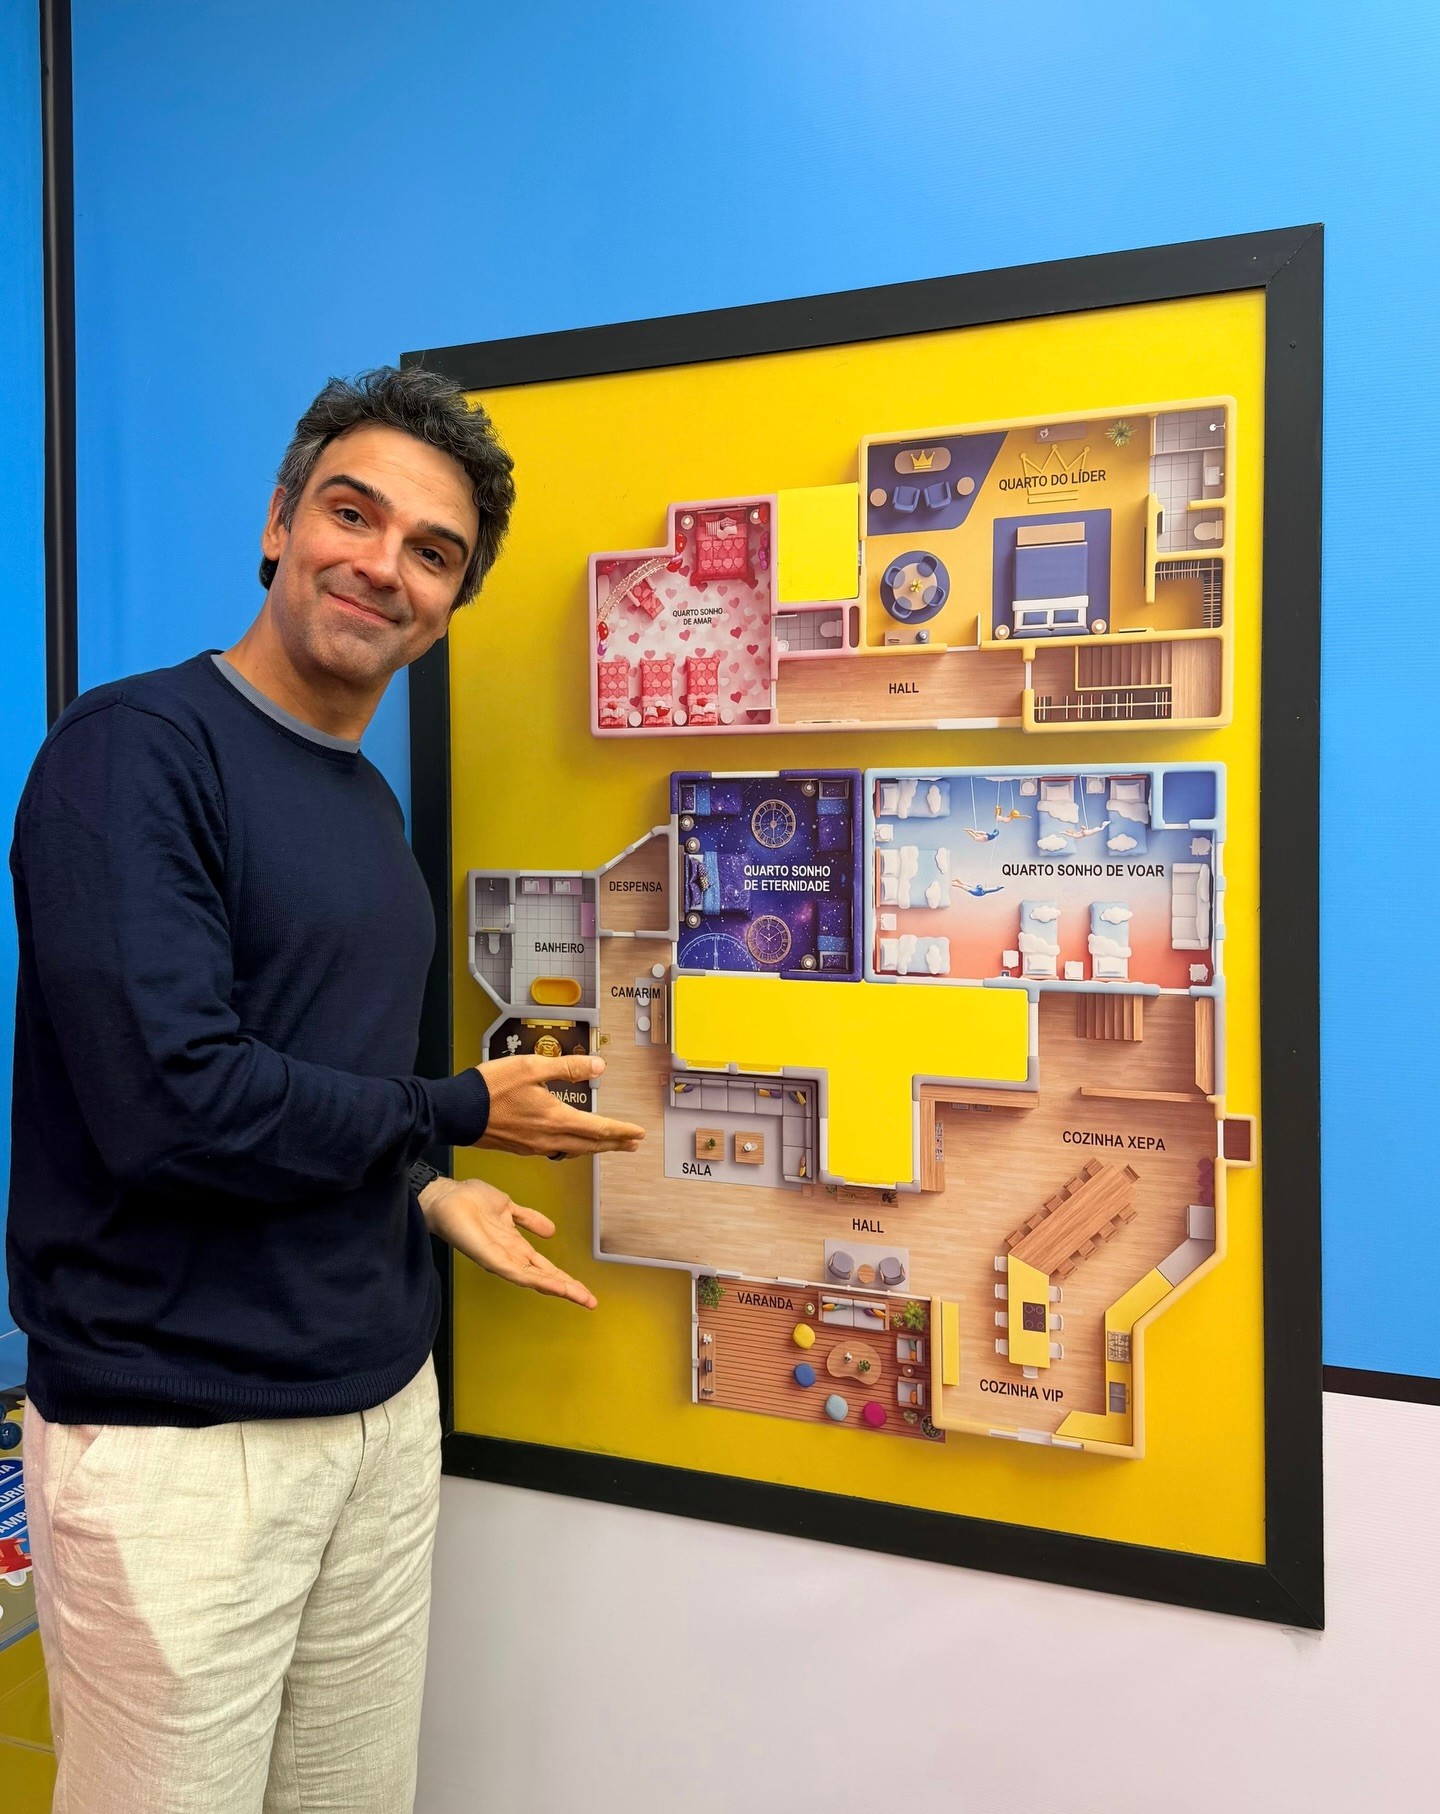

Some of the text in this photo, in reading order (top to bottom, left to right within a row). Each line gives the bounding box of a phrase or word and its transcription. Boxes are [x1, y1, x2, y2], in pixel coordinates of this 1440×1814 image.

[998, 469, 1107, 491] QUARTO DO LÍDER
[672, 607, 723, 617] QUARTO SONHO
[683, 617, 712, 625] DE AMAR
[888, 682, 919, 694] HALL
[743, 865, 831, 877] QUARTO SONHO
[1002, 864, 1165, 877] QUARTO SONHO DE VOAR
[609, 881, 663, 892] DESPENSA
[743, 880, 830, 892] DE ETERNIDADE
[534, 942, 584, 953] BANHEIRO
[611, 986, 661, 999] CAMARIM
[1062, 1131, 1166, 1151] COZINHA XEPA
[682, 1162, 712, 1176] SALA
[852, 1218, 884, 1233] HALL
[737, 1291, 794, 1310] VARANDA
[979, 1379, 1064, 1402] COZINHA VIP
